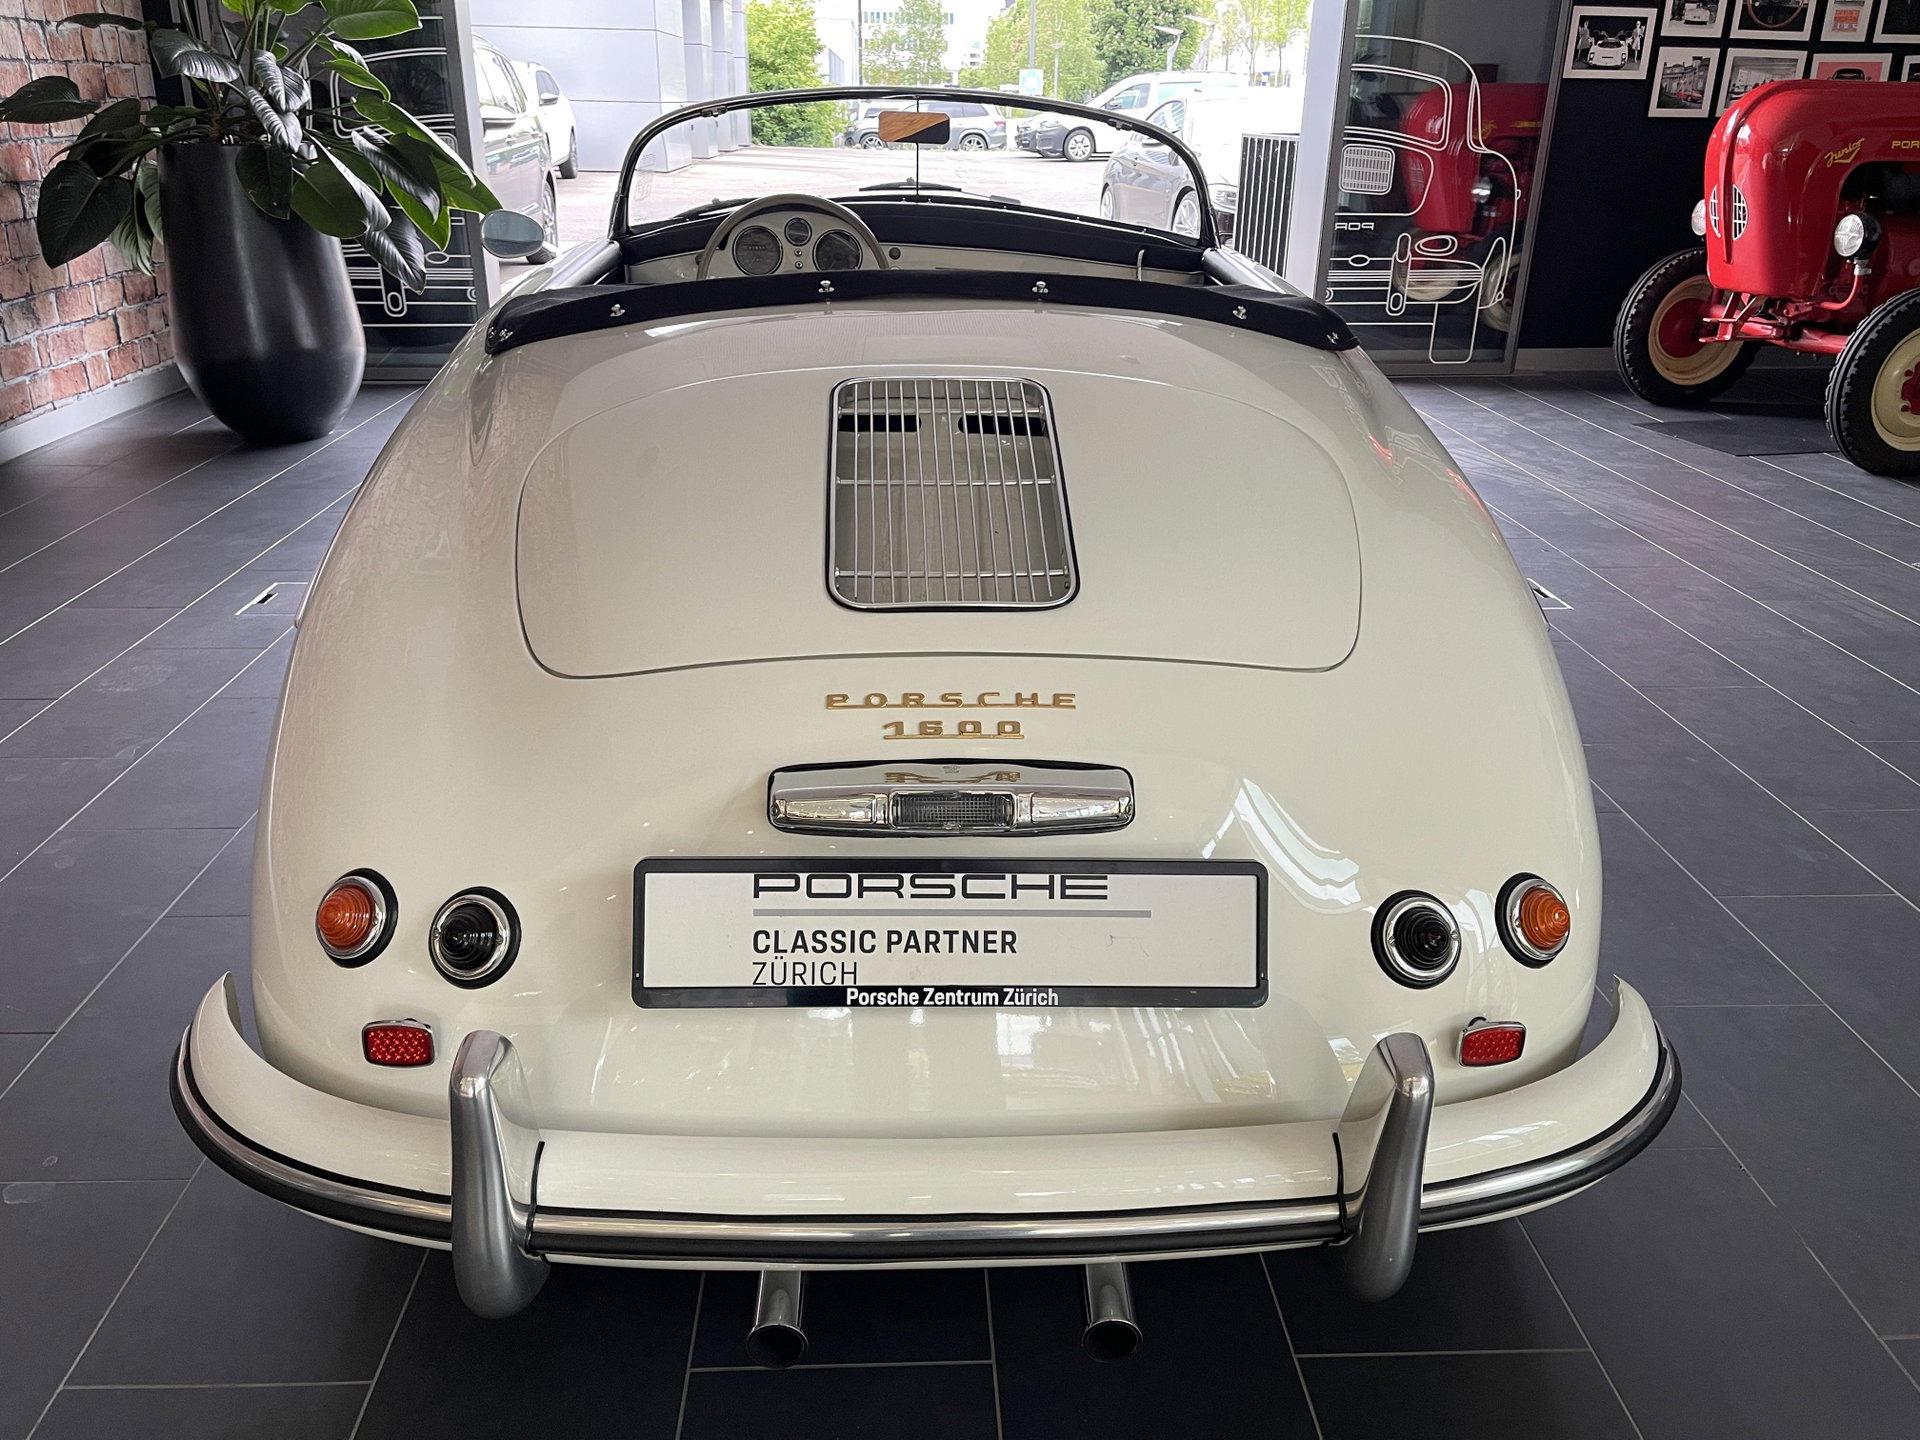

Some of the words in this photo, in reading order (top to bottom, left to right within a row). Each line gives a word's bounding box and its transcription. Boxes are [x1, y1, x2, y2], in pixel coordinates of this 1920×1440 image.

[826, 692, 1076, 710] PORSCHE
[883, 720, 1024, 739] 1600
[753, 873, 1108, 900] PORSCHE
[753, 929, 877, 954] CLASSIC
[887, 929, 1017, 954] PARTNER
[752, 955, 858, 986] ZÜRICH
[846, 987, 920, 1006] Porsche
[923, 987, 999, 1007] Zentrum
[1003, 987, 1059, 1007] Zürich
